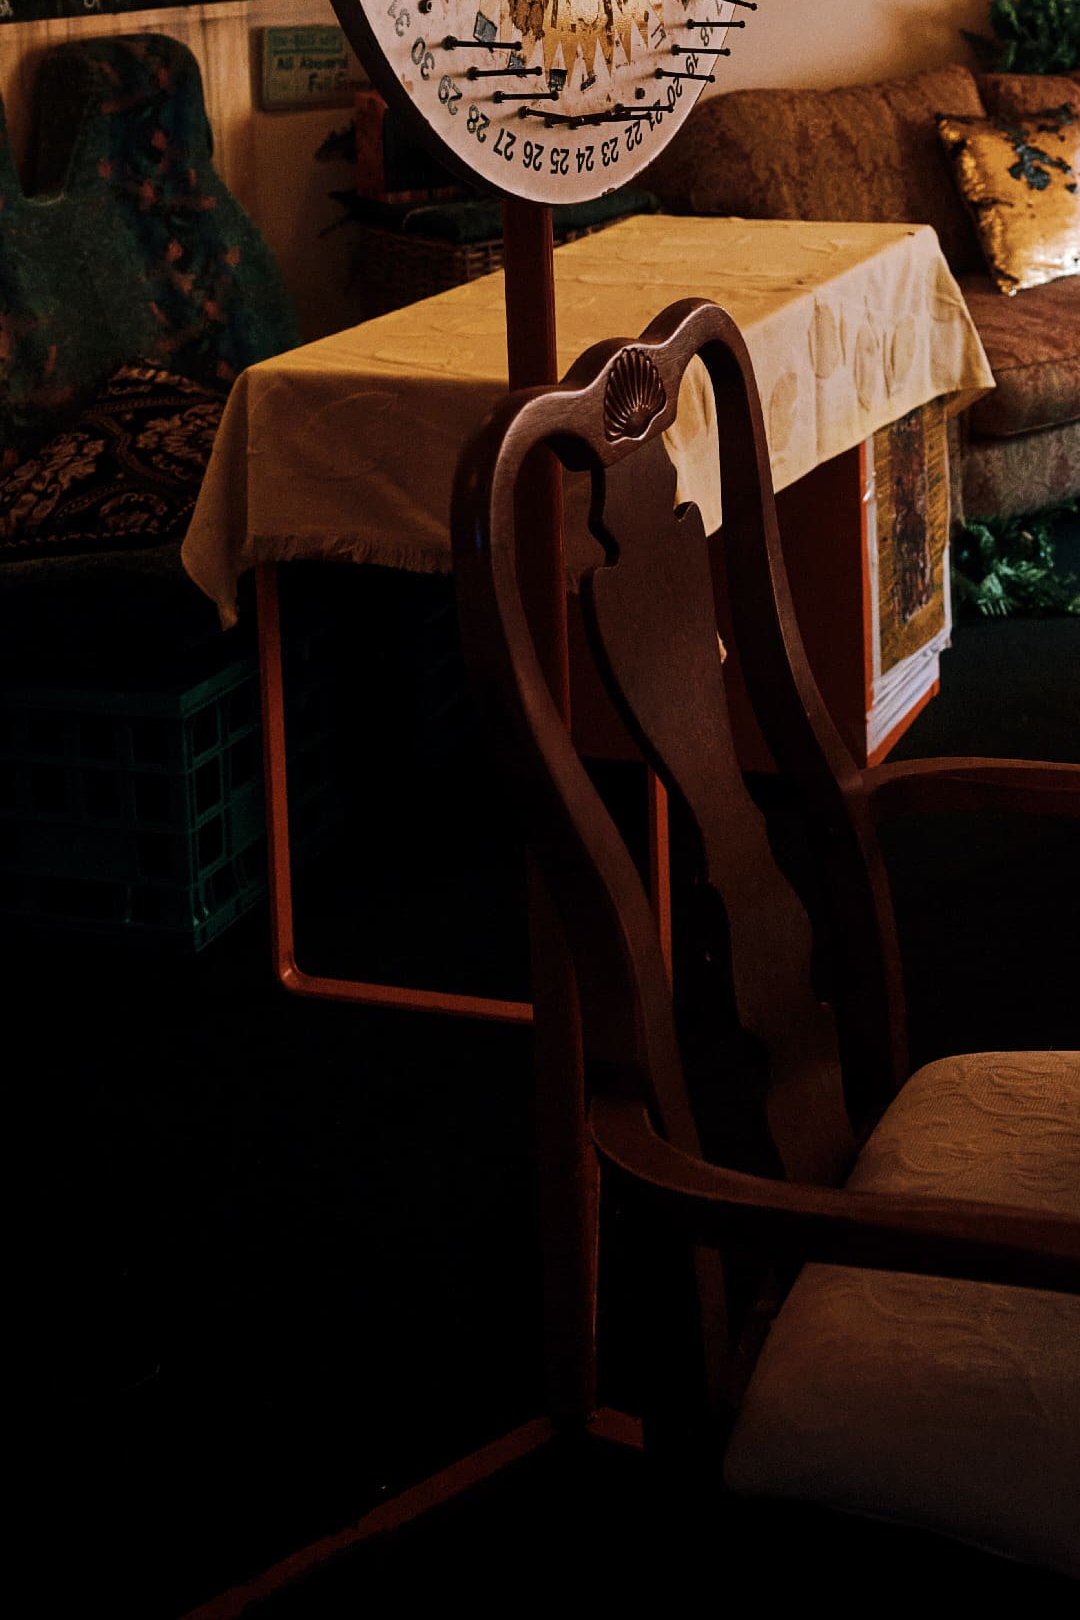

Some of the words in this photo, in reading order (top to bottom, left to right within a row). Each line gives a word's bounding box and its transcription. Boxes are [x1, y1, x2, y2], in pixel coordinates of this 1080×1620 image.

[411, 37, 435, 80] 30
[686, 53, 700, 76] 19
[437, 75, 462, 115] 29
[667, 78, 683, 107] 20
[466, 105, 491, 143] 28
[625, 124, 643, 151] 22
[493, 128, 516, 162] 27
[523, 140, 544, 171] 26
[576, 145, 594, 173] 24
[601, 140, 619, 167] 23
[550, 148, 569, 175] 25
